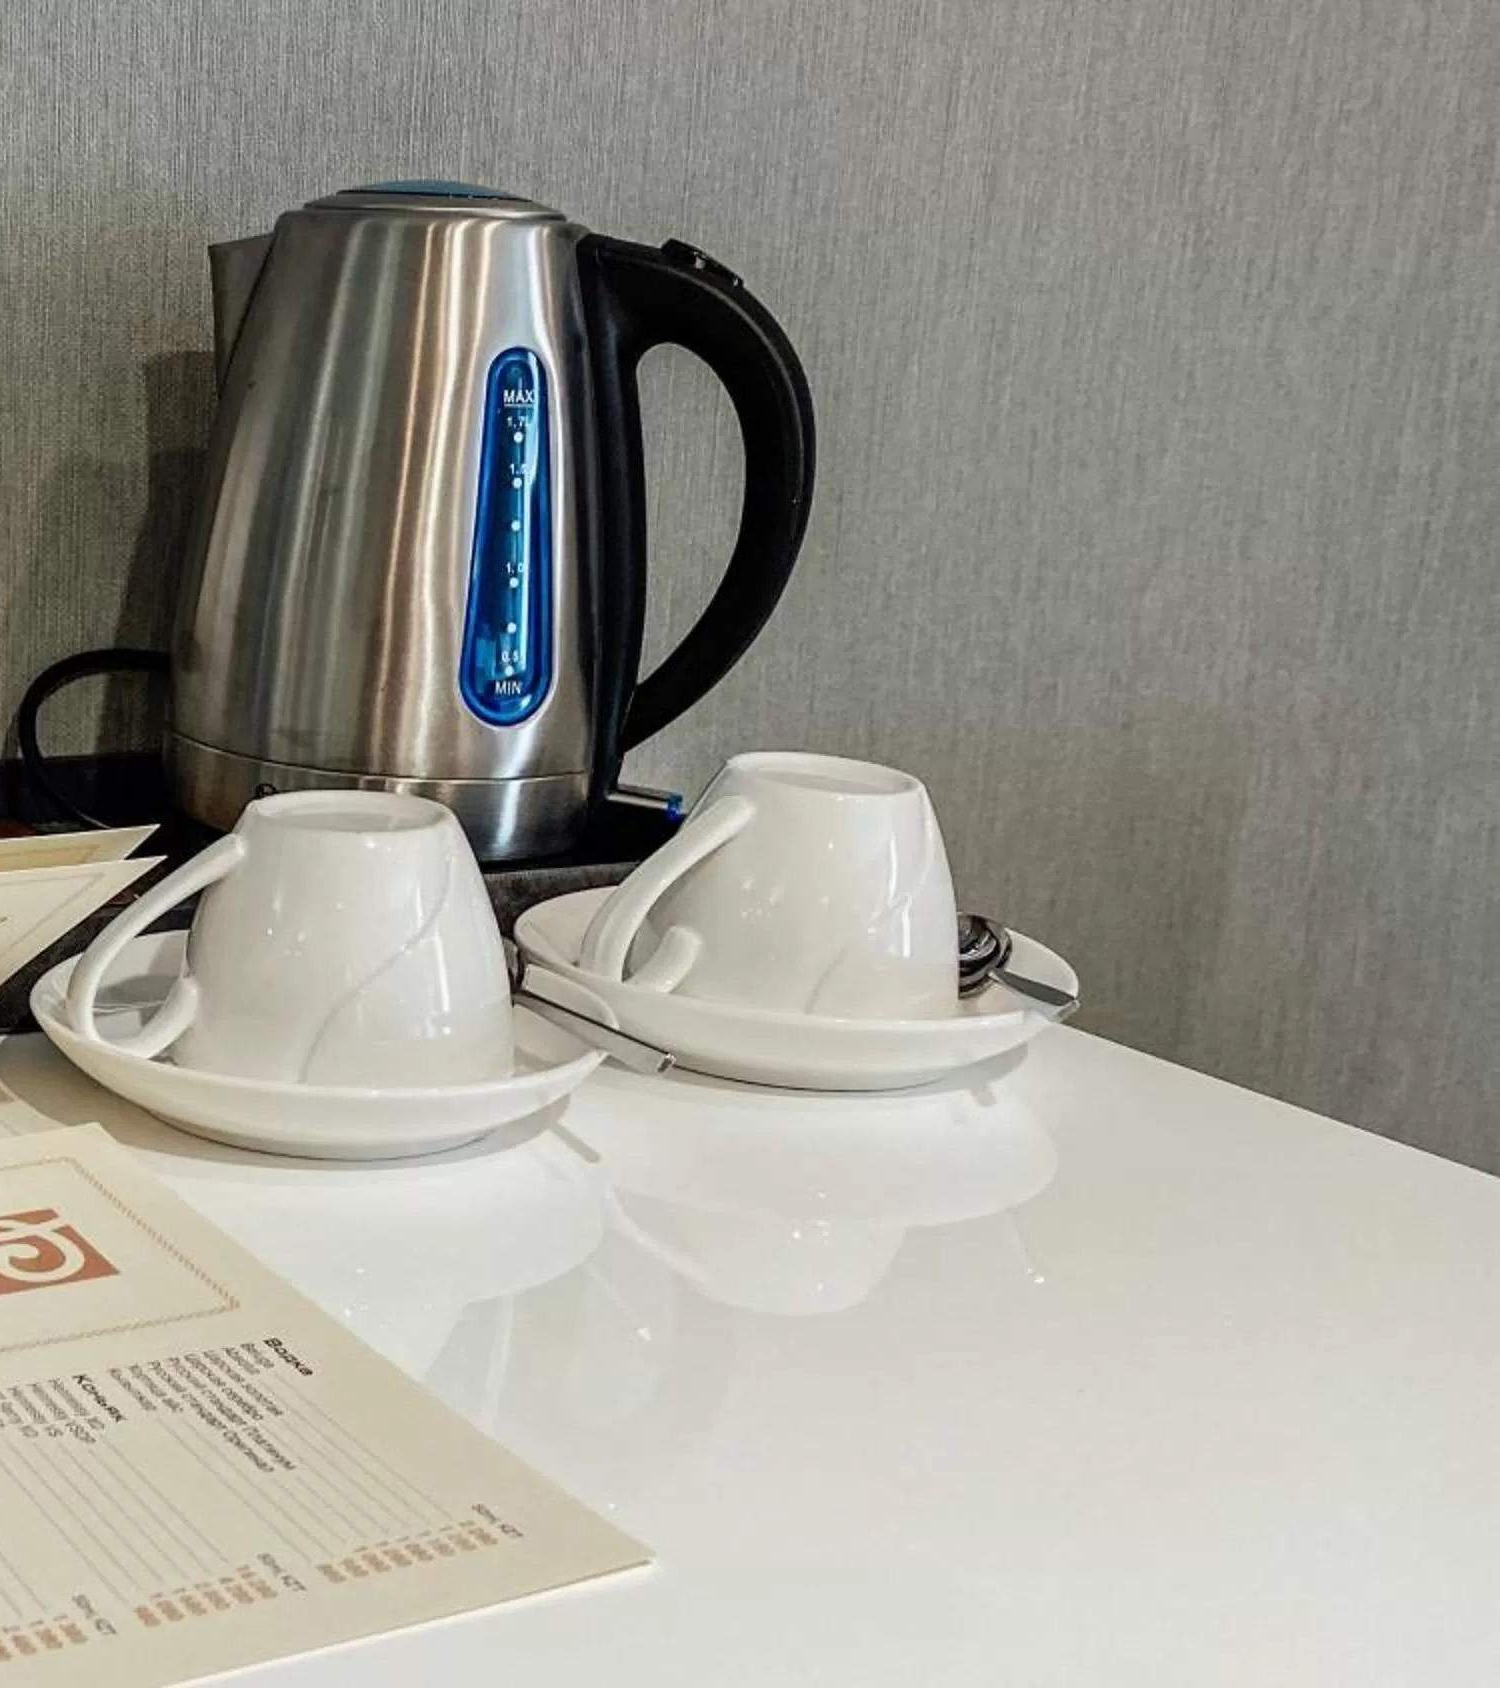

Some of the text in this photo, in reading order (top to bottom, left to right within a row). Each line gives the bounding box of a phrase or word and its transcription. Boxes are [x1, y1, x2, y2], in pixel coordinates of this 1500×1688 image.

[503, 389, 534, 403] MAX
[495, 681, 521, 695] MIN
[260, 1337, 319, 1376] Водка
[69, 1373, 132, 1423] Коньяк
